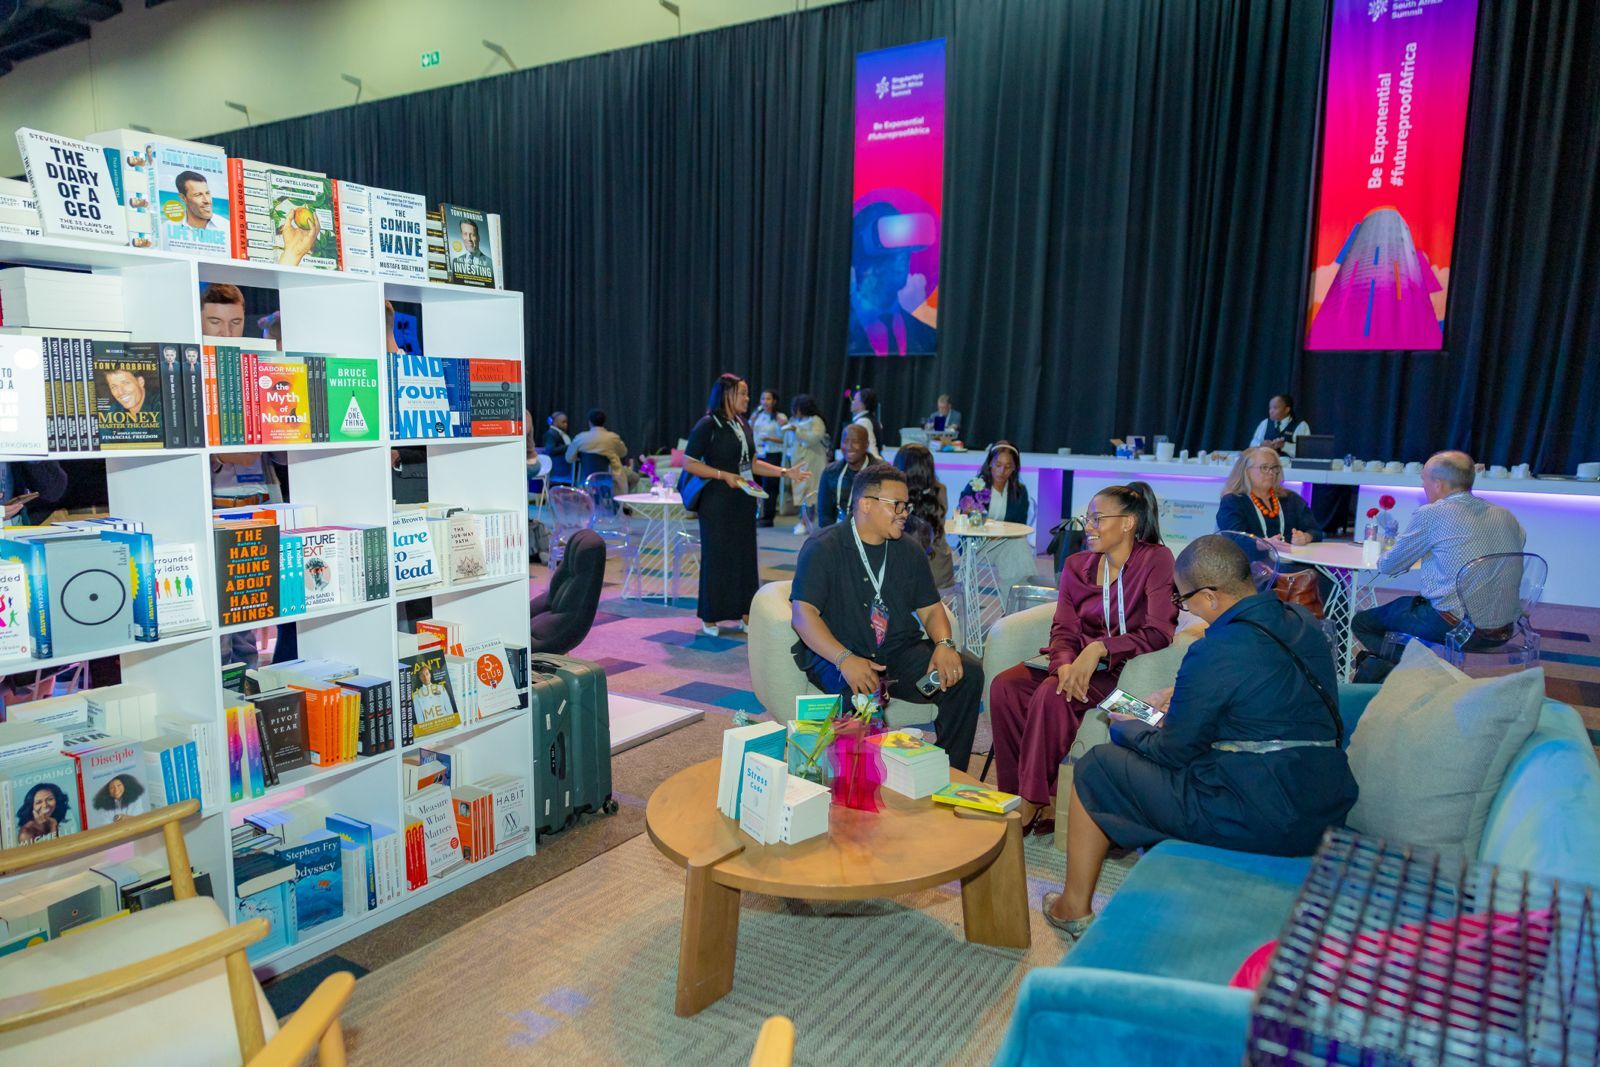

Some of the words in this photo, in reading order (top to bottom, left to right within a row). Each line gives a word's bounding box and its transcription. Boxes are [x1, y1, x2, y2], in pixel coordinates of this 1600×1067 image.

[1392, 8, 1423, 19] Summit
[1370, 73, 1391, 165] Exponential
[1391, 42, 1417, 187] #futureproofAfrica
[29, 132, 60, 145] STEVEN
[62, 140, 100, 154] BARTLETT
[50, 146, 88, 168] THE
[46, 162, 99, 187] DIARY
[1367, 167, 1383, 189] Be
[57, 181, 81, 200] OF
[88, 188, 100, 204] A
[22, 199, 38, 210] THE
[64, 200, 101, 221] CEO
[239, 210, 245, 219] TO
[395, 209, 406, 218] THE
[450, 209, 463, 218] TONY
[60, 223, 93, 233] BUSINESS
[100, 228, 115, 236] LIFE
[82, 220, 102, 229] LAWS
[381, 217, 421, 235] COMING
[167, 224, 190, 240] LIFE
[192, 228, 225, 245] FORCE
[379, 232, 423, 258] WAVE
[379, 261, 400, 270] MUSTAFA
[401, 264, 424, 272] SULEYMAN
[454, 262, 492, 277] INVESTING
[2, 368, 13, 378] TO
[94, 362, 117, 370] TONY
[120, 362, 157, 371] ROBBINS
[338, 368, 367, 377] BRUCE
[330, 378, 377, 388] WHITFIELD
[266, 392, 300, 404] Myth
[398, 385, 449, 400] YOUR
[471, 398, 496, 408] LAWS
[497, 398, 510, 407] OF
[98, 411, 160, 424] MONEY
[261, 413, 307, 423] Normal
[348, 412, 360, 420] ONE
[471, 408, 510, 416] LEADERSHIP
[400, 410, 453, 439] WHY
[401, 516, 424, 524] Brown
[235, 529, 262, 542] THE
[302, 534, 336, 547] UTURE
[230, 544, 268, 559] HARD
[303, 546, 324, 558] EXT
[154, 555, 193, 564] rrounded
[227, 560, 270, 576] THING
[395, 559, 433, 581] lead
[226, 575, 272, 593] ABOUT
[230, 592, 268, 607] HARD
[223, 606, 274, 625] THINGS
[484, 656, 493, 672] 5
[480, 669, 502, 681] CLUB
[271, 713, 298, 725] PIVOT
[424, 705, 444, 719] ME
[273, 724, 297, 734] YEAR
[91, 747, 134, 768] Disciple
[13, 767, 73, 788] BECOMING
[747, 768, 768, 786] Stress
[750, 781, 763, 794] Code
[496, 789, 524, 807] HABIT
[418, 799, 449, 816] Measure
[426, 813, 446, 826] What
[425, 824, 453, 840] Matters
[286, 845, 321, 862] Stephen
[322, 841, 338, 852] Fry
